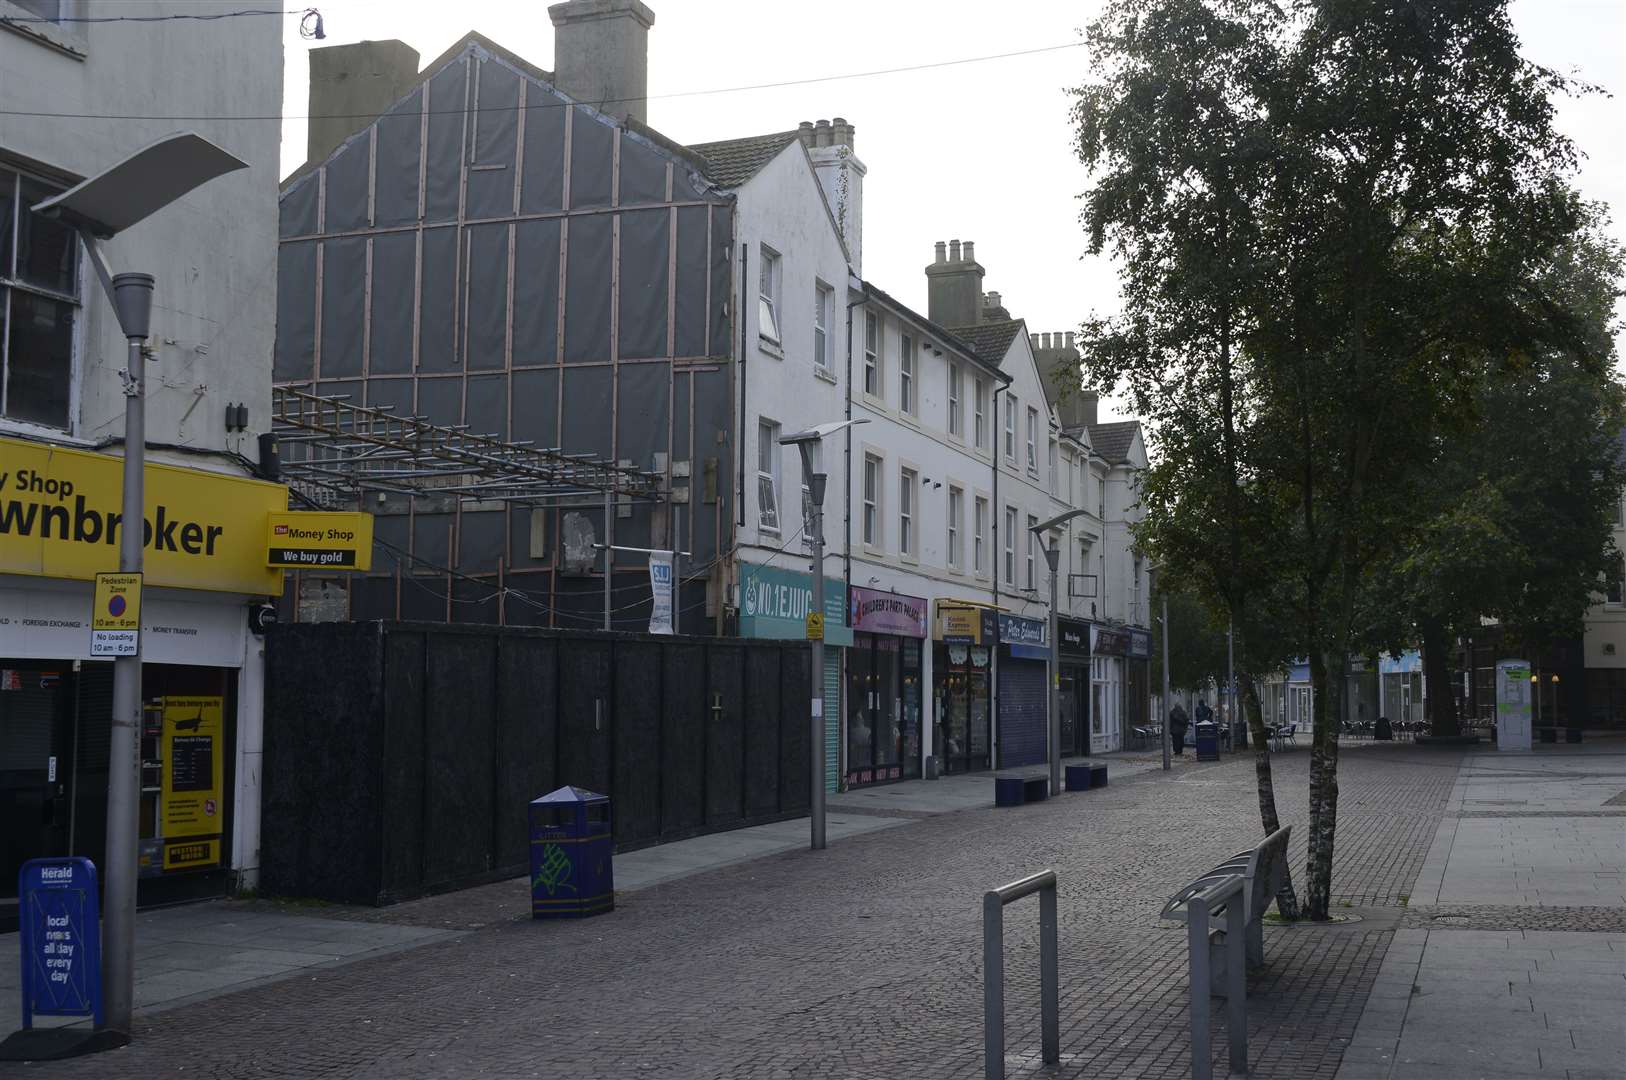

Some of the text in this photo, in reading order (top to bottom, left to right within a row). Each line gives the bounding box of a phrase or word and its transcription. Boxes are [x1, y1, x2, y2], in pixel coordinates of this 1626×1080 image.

[16, 470, 74, 501] Shop
[0, 495, 223, 555] wnbrker
[276, 526, 354, 542] The Money Shop
[283, 551, 342, 564] We buy gold
[101, 576, 137, 585] Pedestrian
[110, 585, 127, 593] Zone
[758, 582, 813, 619] NO.1EJUIC
[23, 619, 49, 627] FOREIGN
[49, 620, 81, 628] EXCHANGE
[152, 626, 172, 634] MONEY
[173, 627, 198, 636] TRANSFER
[126, 620, 137, 628] pm
[97, 633, 133, 643] No loading
[42, 867, 72, 878] Herald
[47, 916, 69, 926] local
[44, 942, 75, 958] all day
[47, 959, 72, 971] every
[51, 971, 69, 984] day
